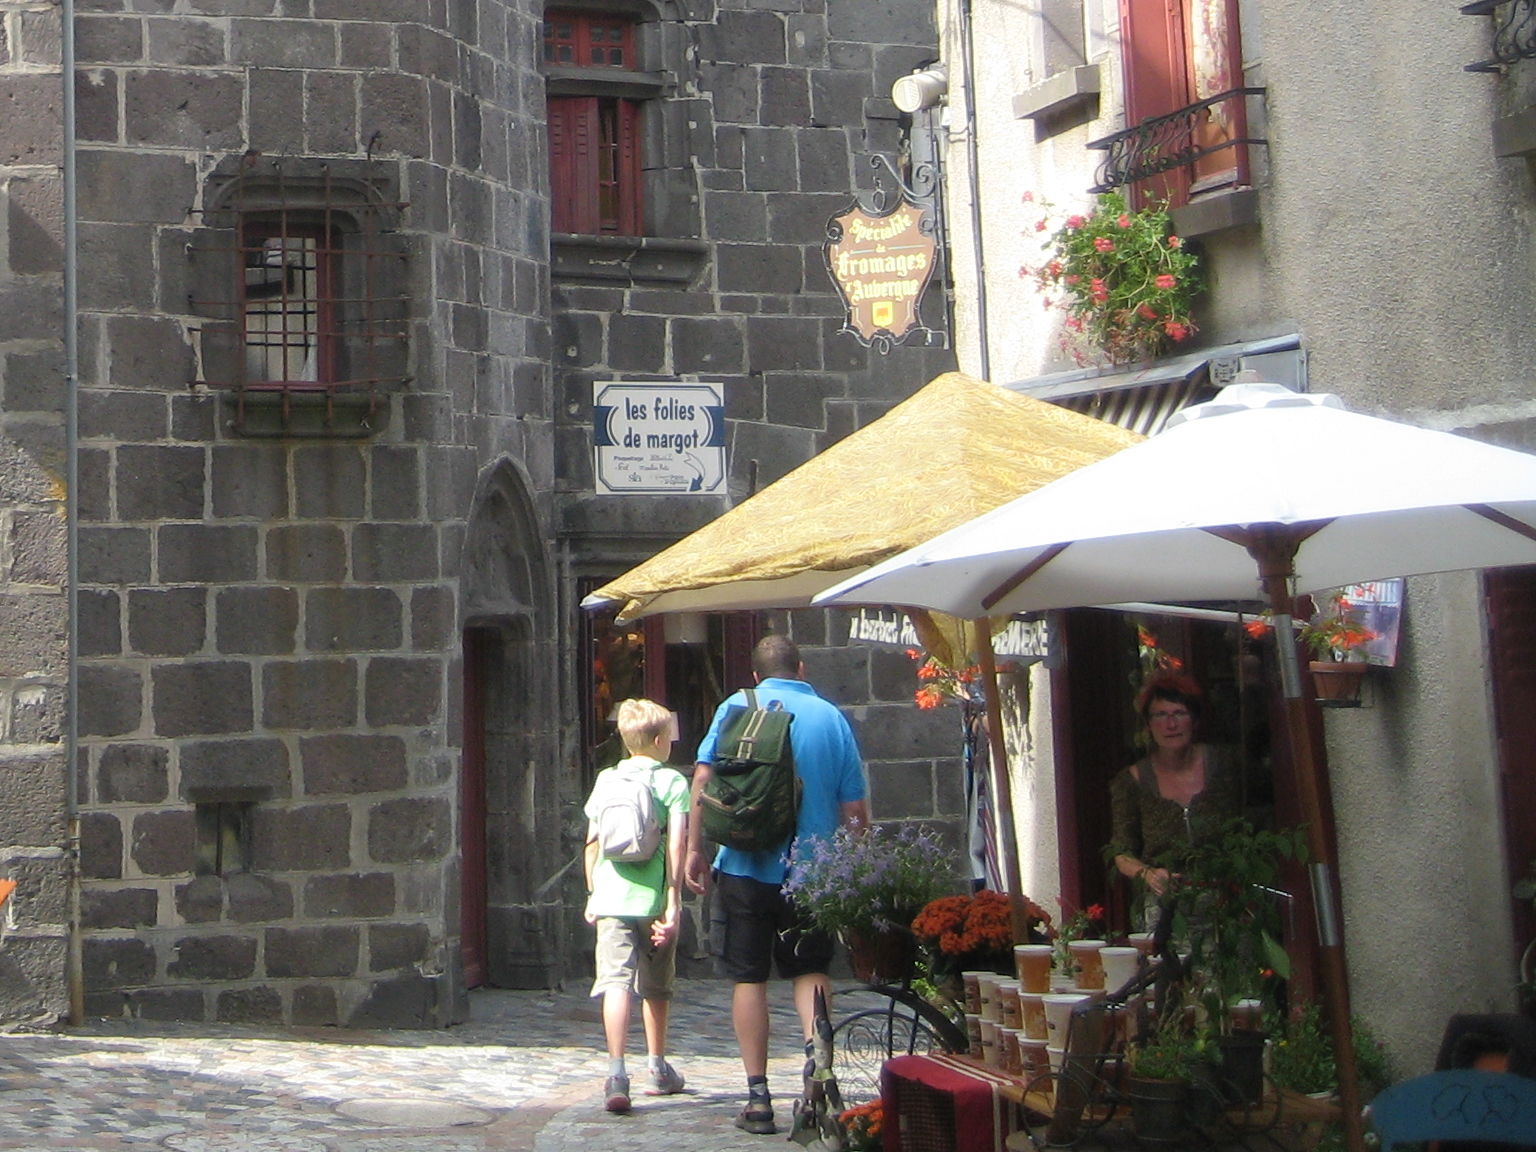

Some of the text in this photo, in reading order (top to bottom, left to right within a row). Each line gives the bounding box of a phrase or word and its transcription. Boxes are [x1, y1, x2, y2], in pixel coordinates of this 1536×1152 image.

[835, 251, 927, 282] Fromages
[625, 396, 695, 421] les folies
[623, 427, 699, 454] de margot
